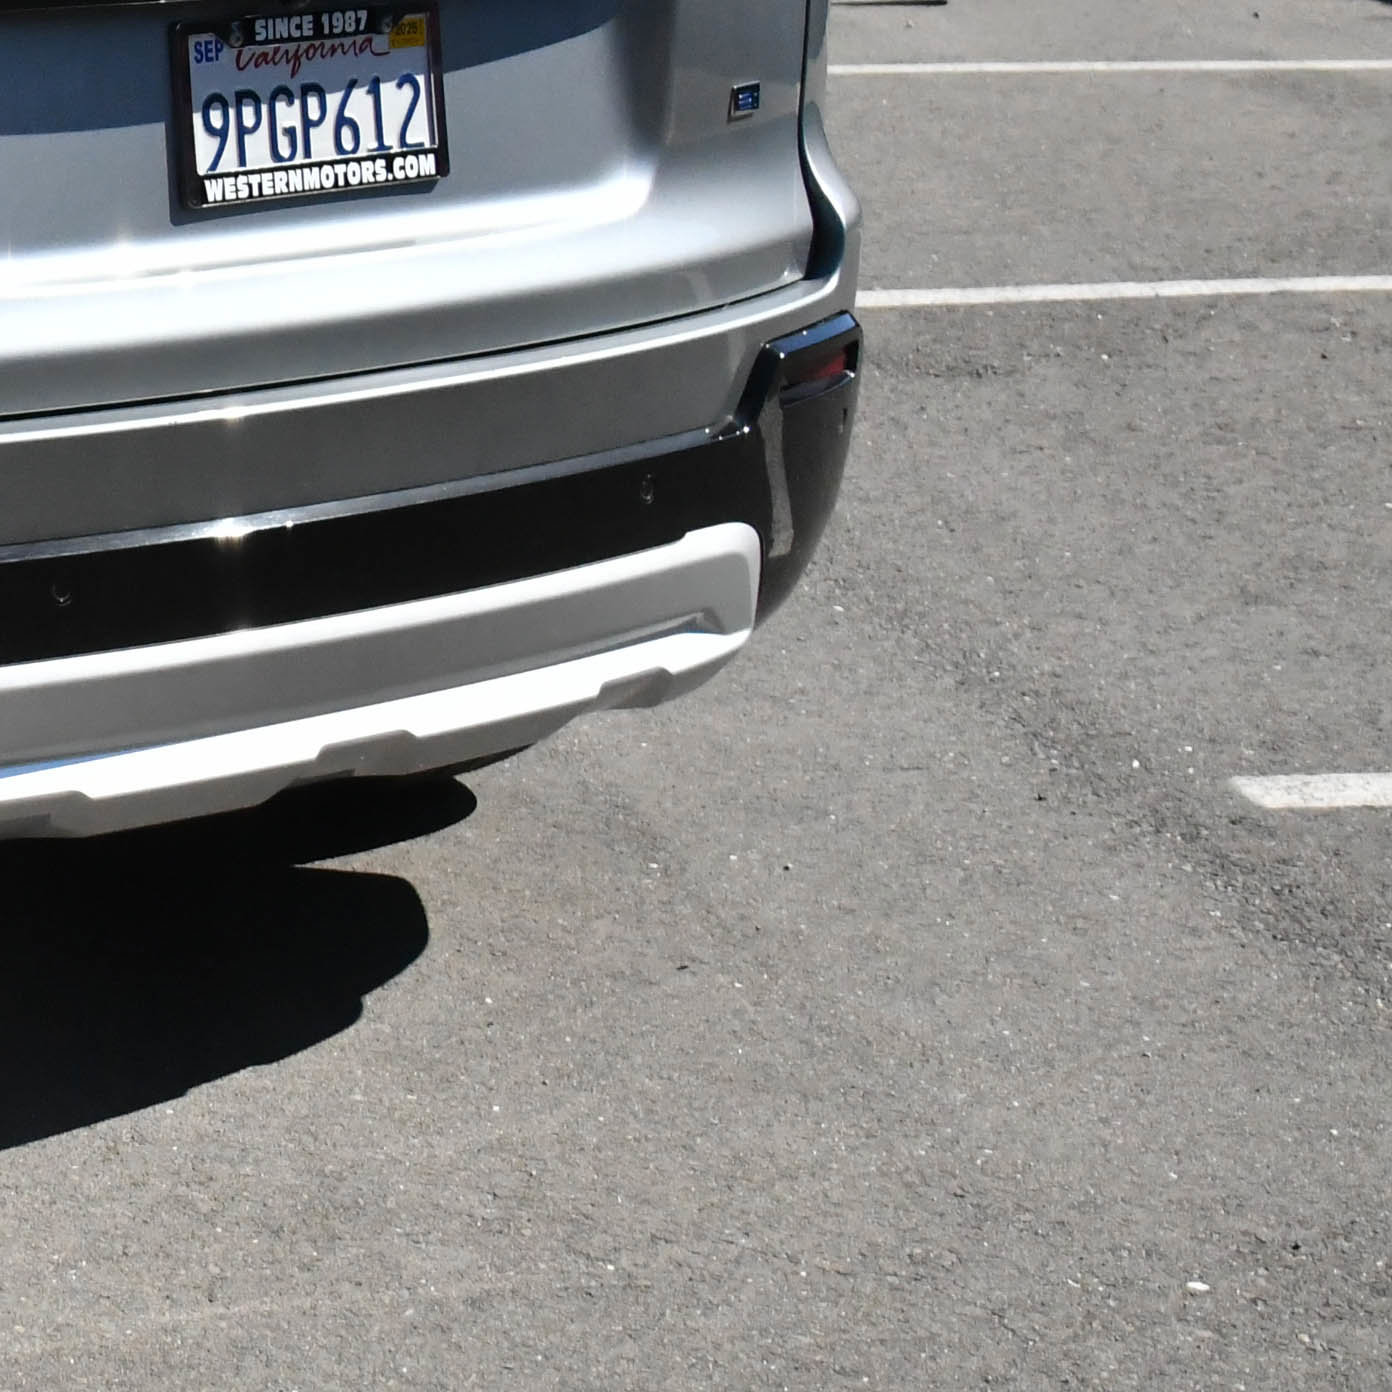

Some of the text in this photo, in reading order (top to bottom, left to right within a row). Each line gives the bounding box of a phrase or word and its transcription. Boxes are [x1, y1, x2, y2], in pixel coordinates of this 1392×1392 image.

[255, 10, 368, 41] SINCE 1987
[194, 39, 224, 64] SEP
[235, 37, 390, 79] California
[201, 73, 425, 173] 9PGP612
[204, 154, 436, 203] WESTERNMOTORS.COM
